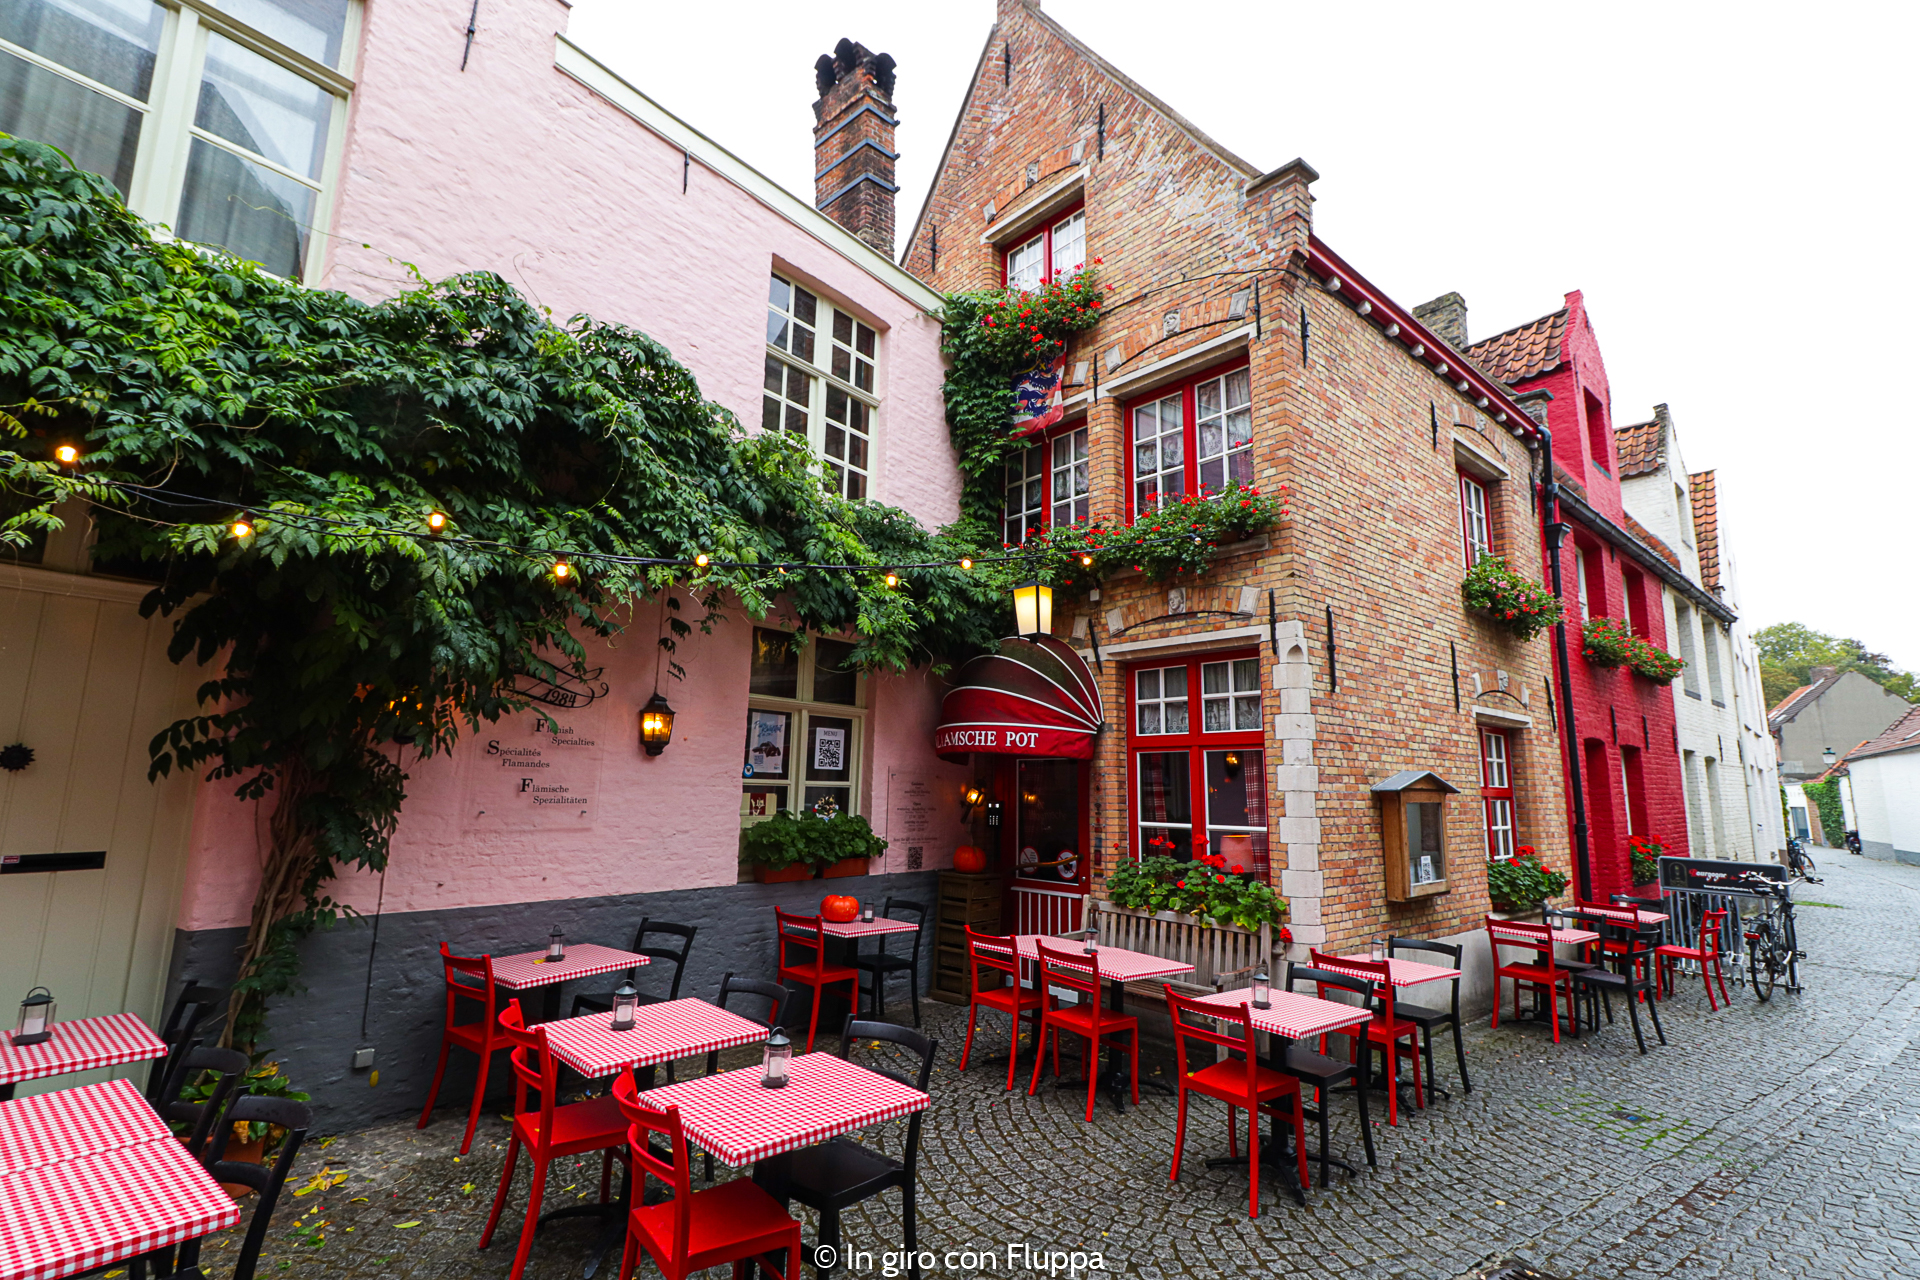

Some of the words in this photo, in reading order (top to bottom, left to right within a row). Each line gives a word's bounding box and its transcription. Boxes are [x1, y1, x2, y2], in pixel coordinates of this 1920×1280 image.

[541, 689, 577, 707] 1984
[551, 736, 595, 747] Specialties
[935, 731, 997, 749] LAAMSCHE
[1005, 731, 1039, 748] POT
[487, 740, 542, 757] Spécialités
[502, 759, 550, 769] Flamandes
[520, 778, 570, 793] Flämische
[533, 796, 588, 805] Spezialitäten
